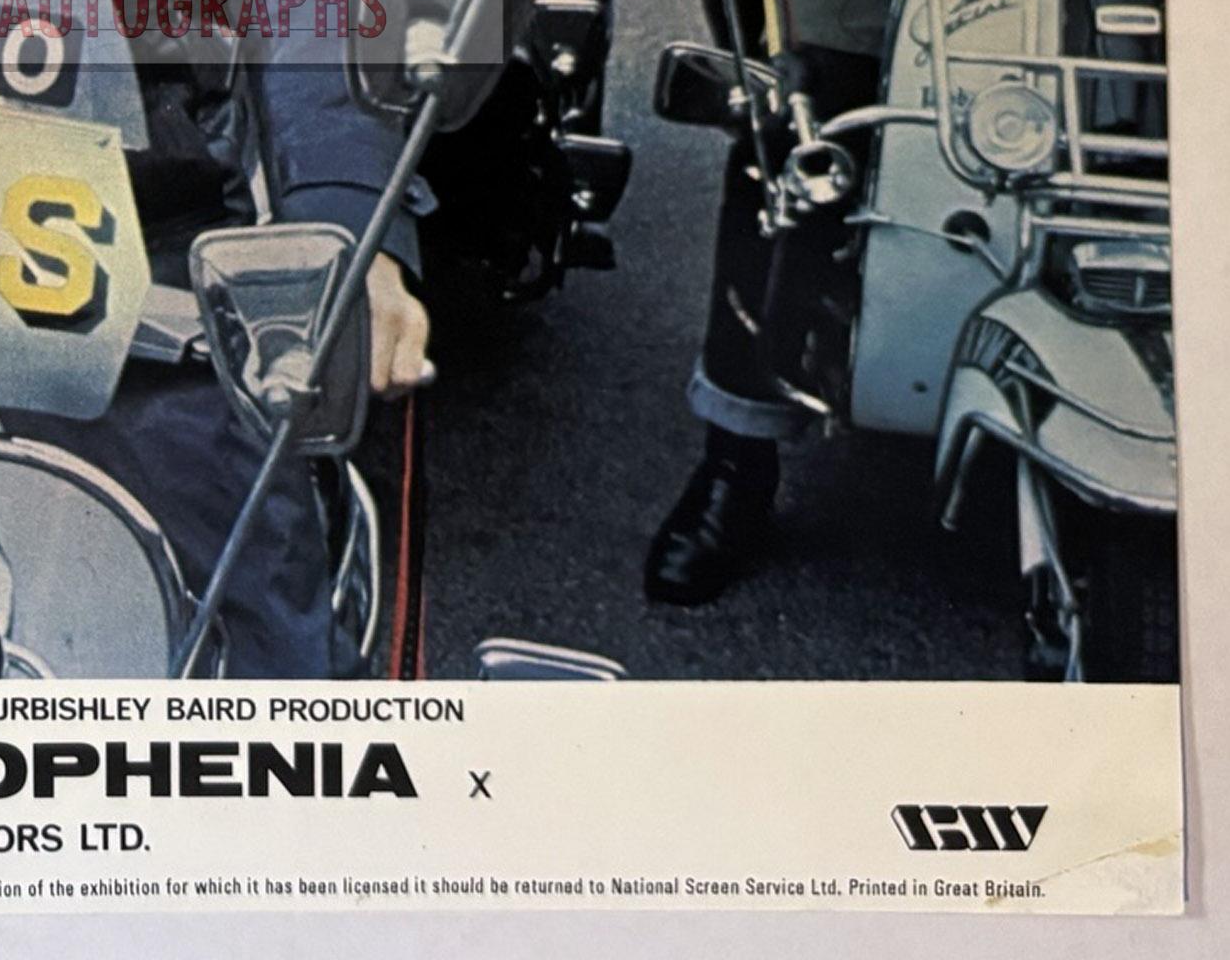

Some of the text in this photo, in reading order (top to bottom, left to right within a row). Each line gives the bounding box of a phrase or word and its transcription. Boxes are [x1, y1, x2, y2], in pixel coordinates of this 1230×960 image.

[165, 696, 258, 723] BAIRD
[268, 696, 466, 724] PRODUCTION
[79, 821, 152, 853] LTD.
[27, 878, 44, 898] of
[48, 878, 75, 898] the
[79, 877, 161, 898] exhibition
[165, 876, 189, 896] for
[193, 876, 243, 896] which
[246, 876, 260, 896] it
[264, 877, 294, 896] has
[297, 876, 338, 896] been
[342, 876, 410, 896] licensed
[413, 875, 427, 895] it
[431, 876, 485, 895] should
[489, 876, 510, 895] be
[513, 876, 584, 896] returned
[588, 879, 606, 896] to
[610, 876, 680, 896] National
[684, 876, 741, 896] Screen
[744, 876, 806, 897] Service
[810, 877, 843, 897] Ltd.
[848, 877, 908, 897] Printed
[912, 877, 929, 897] in
[933, 878, 980, 898] Great
[984, 878, 1047, 900] Britain.
